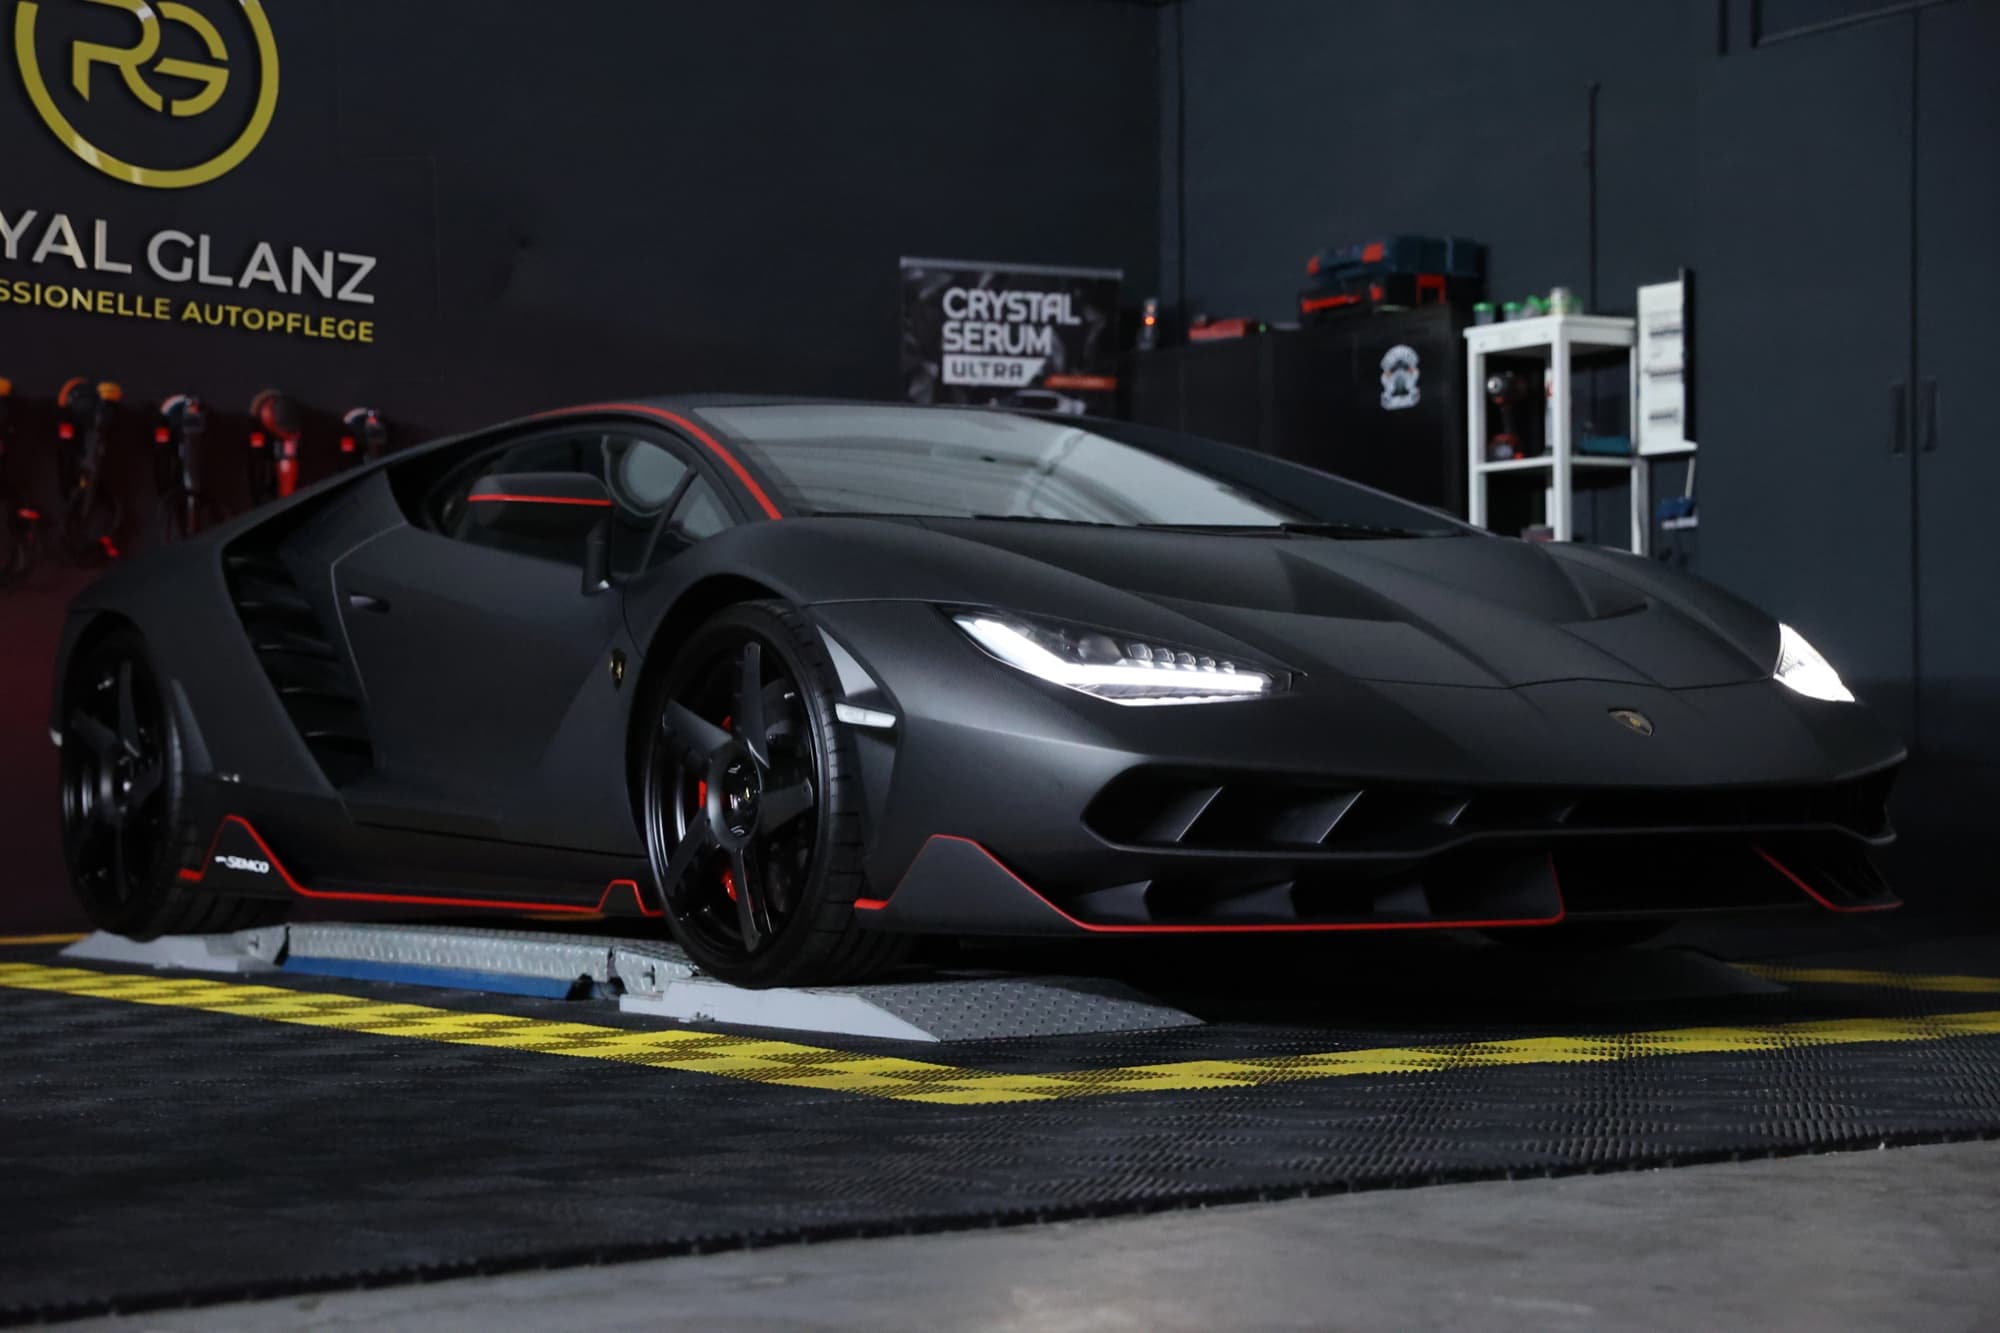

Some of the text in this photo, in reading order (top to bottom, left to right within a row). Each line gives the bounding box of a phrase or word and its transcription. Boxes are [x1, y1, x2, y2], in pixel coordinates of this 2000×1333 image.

[0, 209, 377, 304] YAL GLANZ
[182, 301, 374, 342] AUTOPFLEGE
[942, 287, 1081, 325] CRYSTAL
[942, 321, 1053, 355] SERUM
[951, 361, 1024, 379] ULTRA
